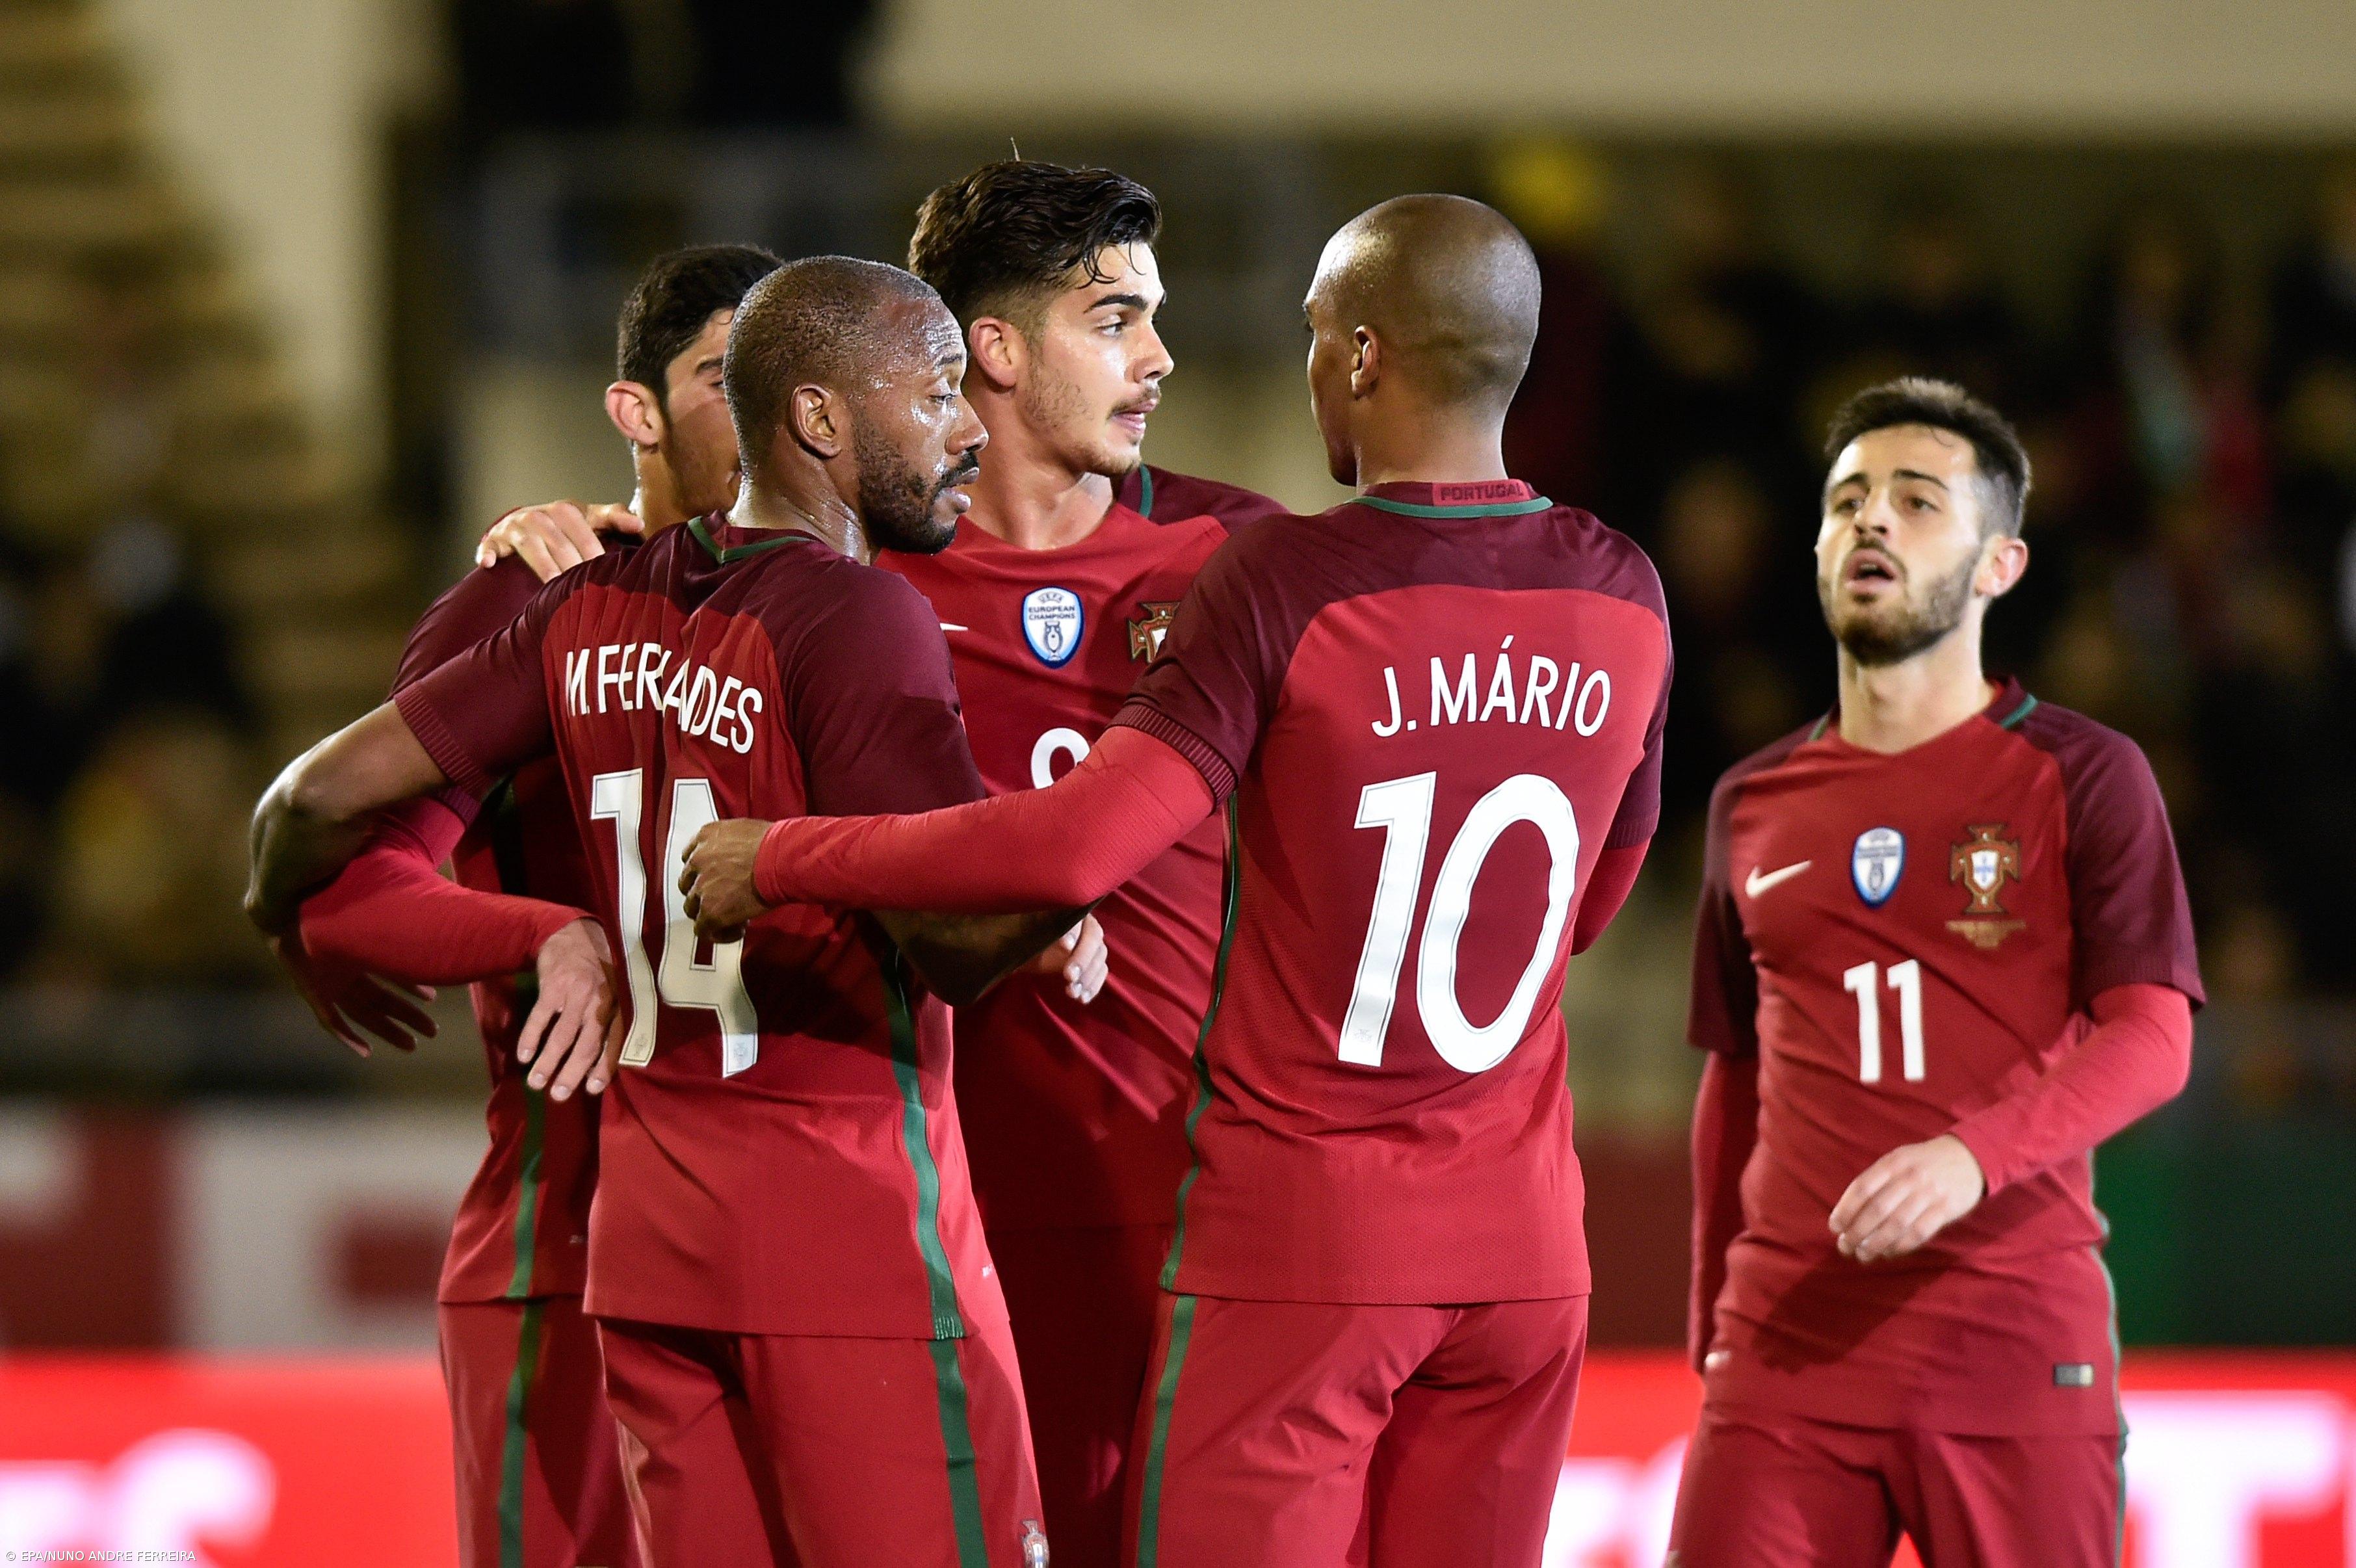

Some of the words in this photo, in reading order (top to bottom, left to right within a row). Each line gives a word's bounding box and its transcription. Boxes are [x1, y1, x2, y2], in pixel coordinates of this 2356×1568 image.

[1440, 484, 1524, 501] PORTUGAL
[1372, 666, 1417, 737] J.
[1430, 634, 1611, 737] MÁRIO
[590, 768, 758, 1078] 14
[1338, 771, 1579, 1073] 10
[1843, 959, 1925, 1083] 11
